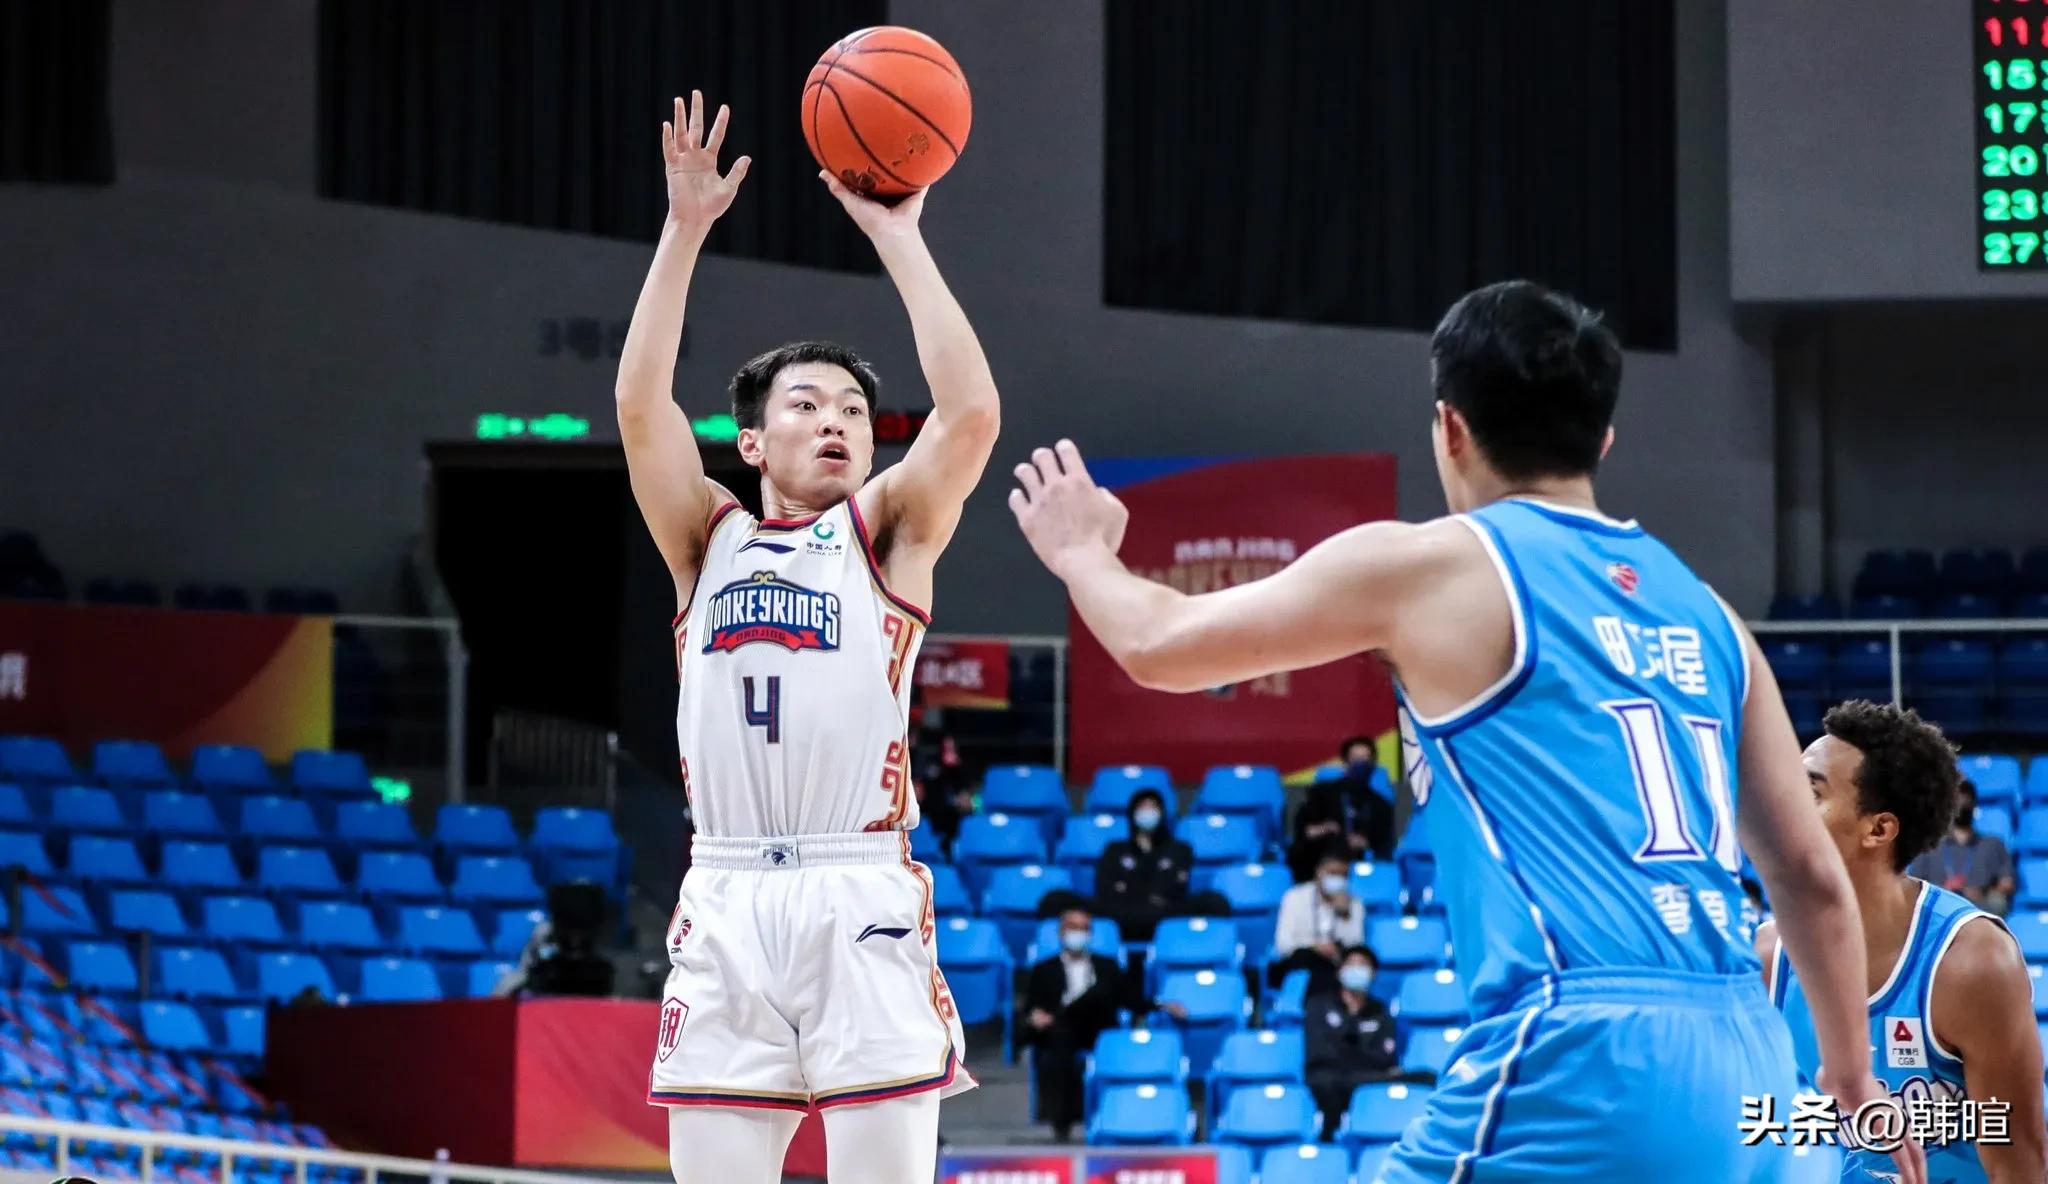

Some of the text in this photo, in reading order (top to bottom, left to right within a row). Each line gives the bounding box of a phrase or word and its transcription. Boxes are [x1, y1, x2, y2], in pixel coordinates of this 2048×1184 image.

[1983, 101, 2038, 134] 17
[1981, 144, 2039, 177] 20
[1982, 188, 2039, 221] 23
[1983, 231, 2040, 265] 27
[742, 675, 781, 745] 4
[1598, 697, 1742, 873] 11
[1897, 1057, 1916, 1066] CGB
